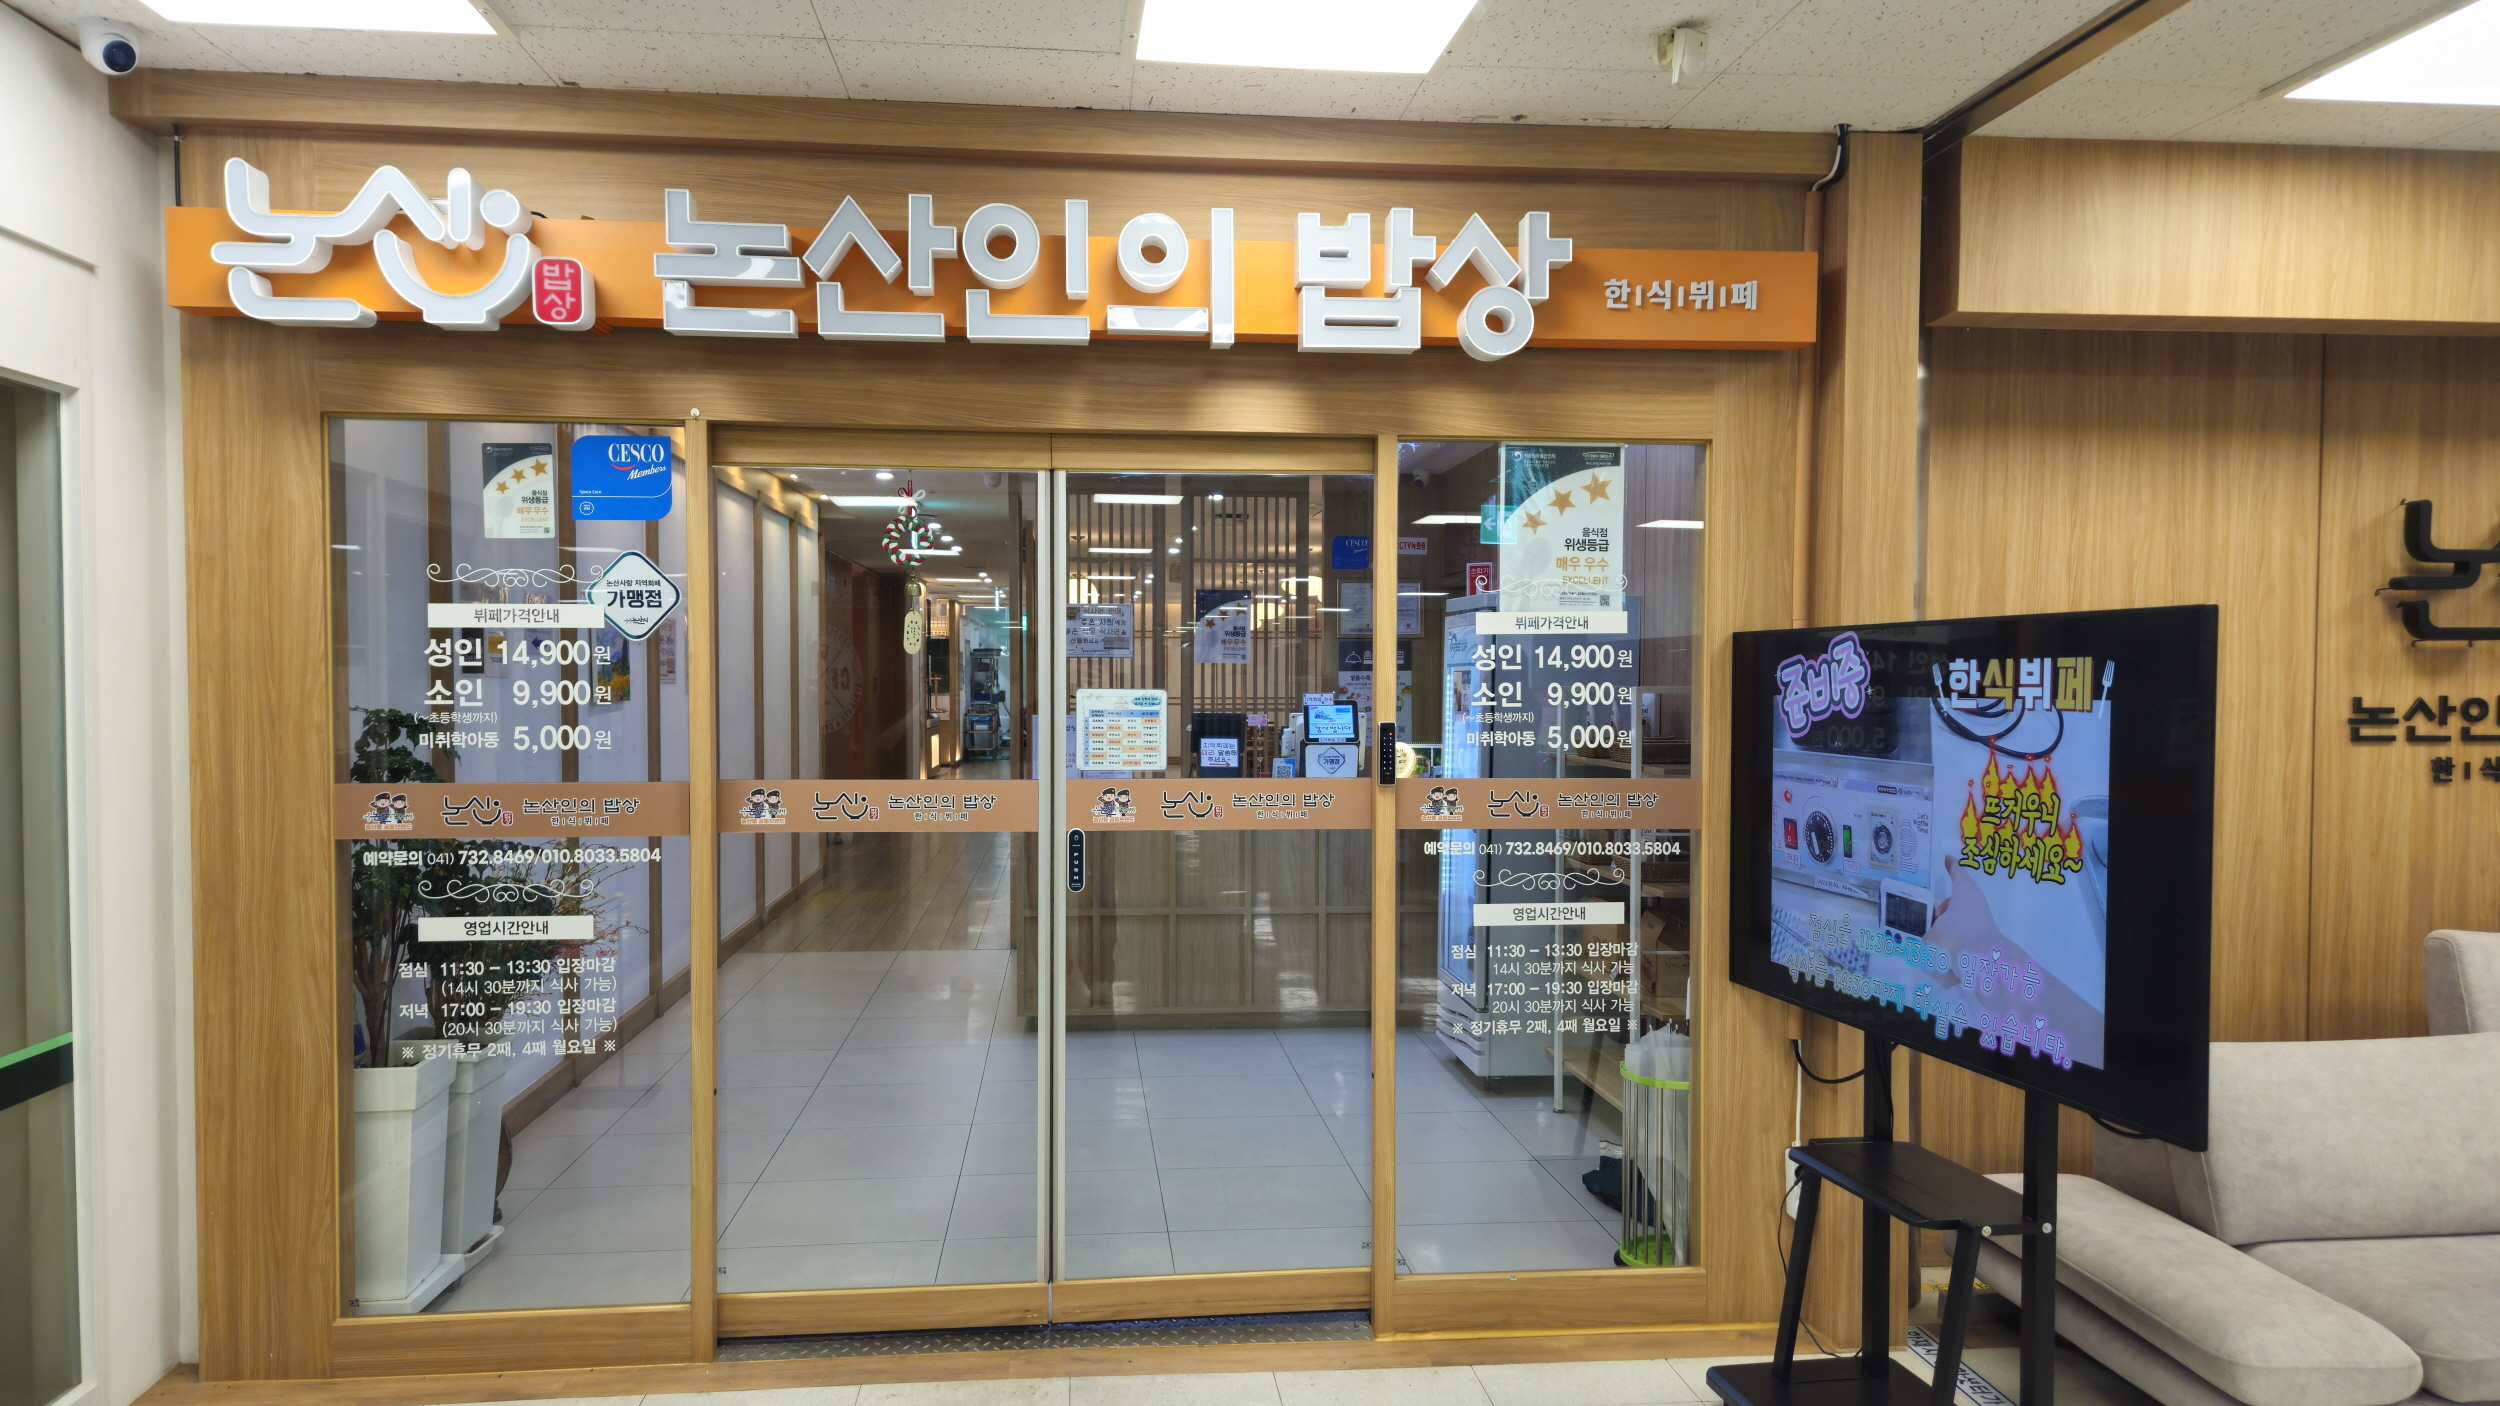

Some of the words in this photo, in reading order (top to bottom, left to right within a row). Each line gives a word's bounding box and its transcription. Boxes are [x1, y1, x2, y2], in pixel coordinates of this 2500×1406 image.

[653, 187, 1234, 350] 논산인의
[1294, 207, 1573, 362] 밥상
[541, 261, 576, 321] 밥상
[608, 443, 665, 463] CESCO
[626, 464, 667, 480] Members
[521, 496, 549, 504] 위생등급
[517, 507, 532, 515] 매우
[533, 507, 549, 515] 우수
[1582, 527, 1608, 537] 음식점
[1564, 538, 1609, 552] 위생등급
[1470, 566, 1489, 575] 소화기
[1556, 557, 1581, 572] 매우
[1584, 557, 1609, 572] 우수
[1562, 576, 1609, 585] EXCELLENT
[606, 589, 662, 608] 가맹점
[473, 608, 560, 624] 뷔페가격안내
[1515, 615, 1589, 631] 뷔페가격안내
[423, 638, 483, 667] 성인
[1471, 644, 1522, 671] 성인
[423, 679, 483, 707] 소인
[1779, 634, 1868, 735] 준비중
[1948, 657, 2095, 712] 한식뷔페
[1471, 682, 1522, 708] 소인
[419, 731, 500, 749] 미취학아동
[1466, 730, 1536, 748] 미취학아동
[522, 798, 597, 814] 논산인의
[603, 798, 640, 814] 밥상
[888, 795, 956, 810] 논산인의
[963, 795, 997, 810] 밥상
[1231, 793, 1297, 808] 논산인의
[1303, 793, 1335, 808] 밥상
[1556, 793, 1621, 808] 논산인의
[1626, 792, 1659, 808] 밥상
[1981, 790, 2061, 838] 뜨거우니
[363, 850, 423, 866] 예약문의
[427, 852, 455, 866] 041)
[458, 847, 662, 866] 732.8469/010.8033.5804
[1423, 841, 1475, 856] 예약문의
[1478, 843, 1503, 856] 041)
[1505, 841, 1681, 856] 732.8469/010.8033.5804
[1958, 832, 2083, 886] 조심하세요~
[1512, 906, 1587, 921] 영업시간안내
[463, 920, 550, 936] 영업시간안내
[1450, 944, 1477, 960] 점심
[1487, 944, 1525, 958] 11:30
[1544, 943, 1582, 957] 13:30
[1587, 942, 1639, 957] 입장마감
[1809, 913, 1852, 947] 점심은
[1859, 928, 1949, 971] 11:30~13:30
[1960, 949, 2041, 1000] 입장가능
[398, 962, 428, 978] 점심
[440, 962, 484, 976] 11:30
[506, 960, 550, 975] 13:30
[556, 957, 616, 974] 입장마감
[1493, 962, 1520, 976] 14시
[1524, 961, 1577, 976] 30분까지
[1581, 960, 1606, 975] 식사
[1610, 960, 1635, 975] 가능
[441, 980, 478, 997] (14시
[484, 978, 545, 995] 30분까지
[550, 978, 579, 994] 식사
[584, 977, 617, 993] 가능)
[1450, 982, 1477, 998] 저녁
[1487, 982, 1525, 996] 17:00
[1544, 981, 1582, 995] 19:30
[1587, 980, 1639, 995] 입장마감
[399, 1003, 429, 1019] 저녁
[441, 1003, 485, 1018] 17:00
[508, 1001, 551, 1016] 19:30
[557, 999, 616, 1015] 입장마감
[1492, 1000, 1520, 1014] 20시
[1524, 999, 1577, 1014] 30분까지
[1581, 998, 1606, 1013] 식사
[1610, 998, 1635, 1013] 가능
[1785, 949, 1828, 985] 식사는
[1833, 969, 1906, 1011] 14:30까지
[1979, 1012, 2072, 1068] 있습니다.
[442, 1021, 479, 1038] (20시
[484, 1019, 545, 1036] 30분까지
[551, 1018, 579, 1035] 식사
[584, 1017, 617, 1034] 가능)
[1469, 1019, 1522, 1036] 정기휴무
[1526, 1020, 1551, 1035] 2째,
[1557, 1018, 1578, 1033] 4째
[1582, 1018, 1621, 1033] 월요일
[422, 1042, 482, 1059] 정기휴무
[487, 1042, 516, 1058] 2째,
[522, 1040, 546, 1056] 4째
[552, 1039, 596, 1055] 월요일
